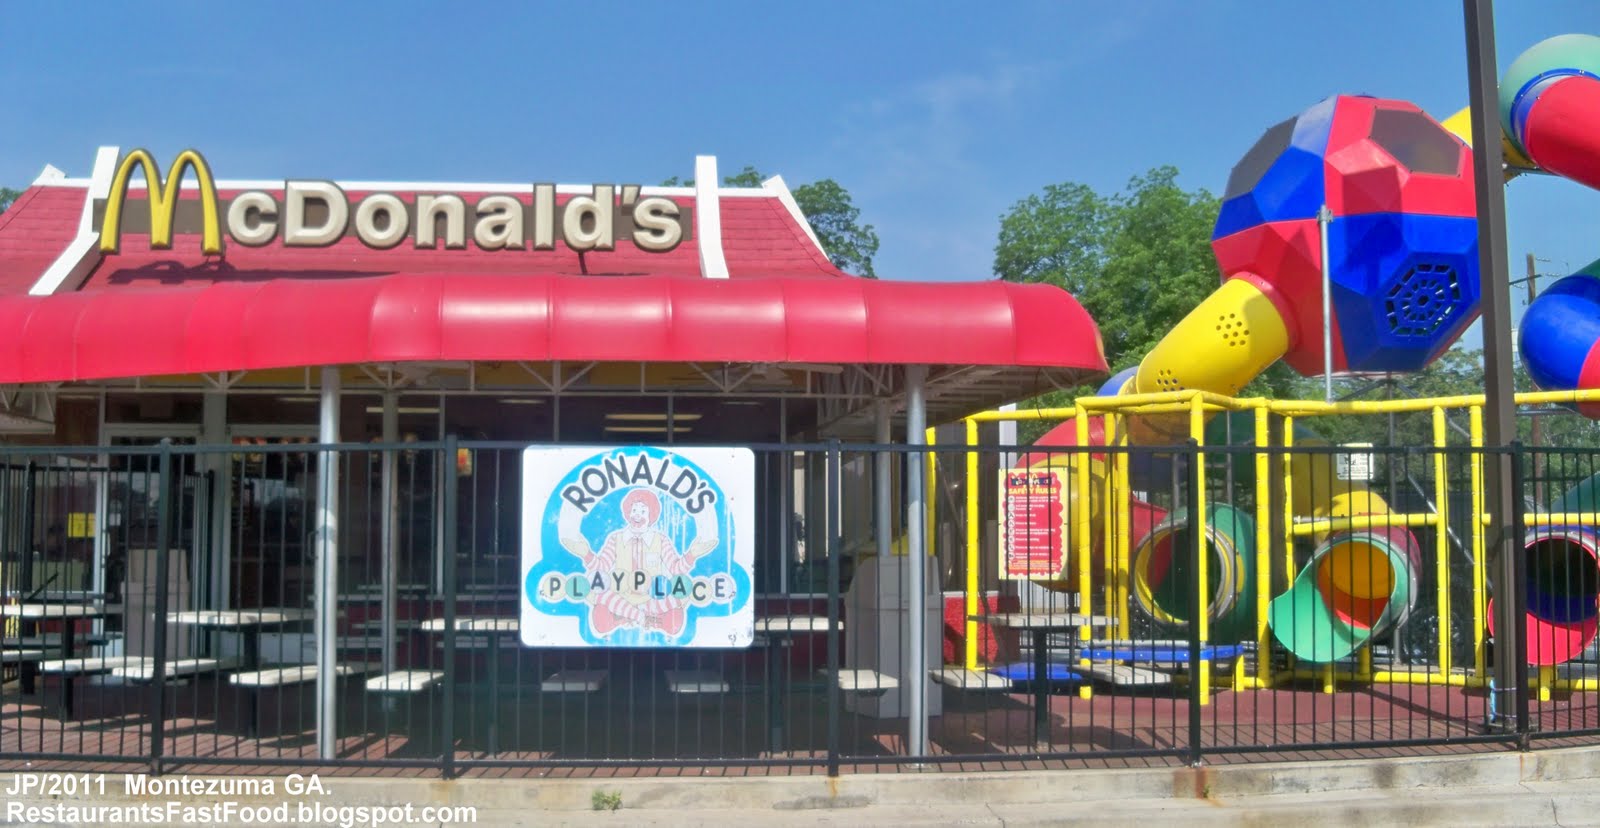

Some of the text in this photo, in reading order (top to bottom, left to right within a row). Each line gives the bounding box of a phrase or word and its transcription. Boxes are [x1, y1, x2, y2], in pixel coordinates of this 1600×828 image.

[99, 148, 684, 256] McDonald's
[562, 454, 715, 514] RONALD'S
[549, 571, 726, 601] PLAYPLACE
